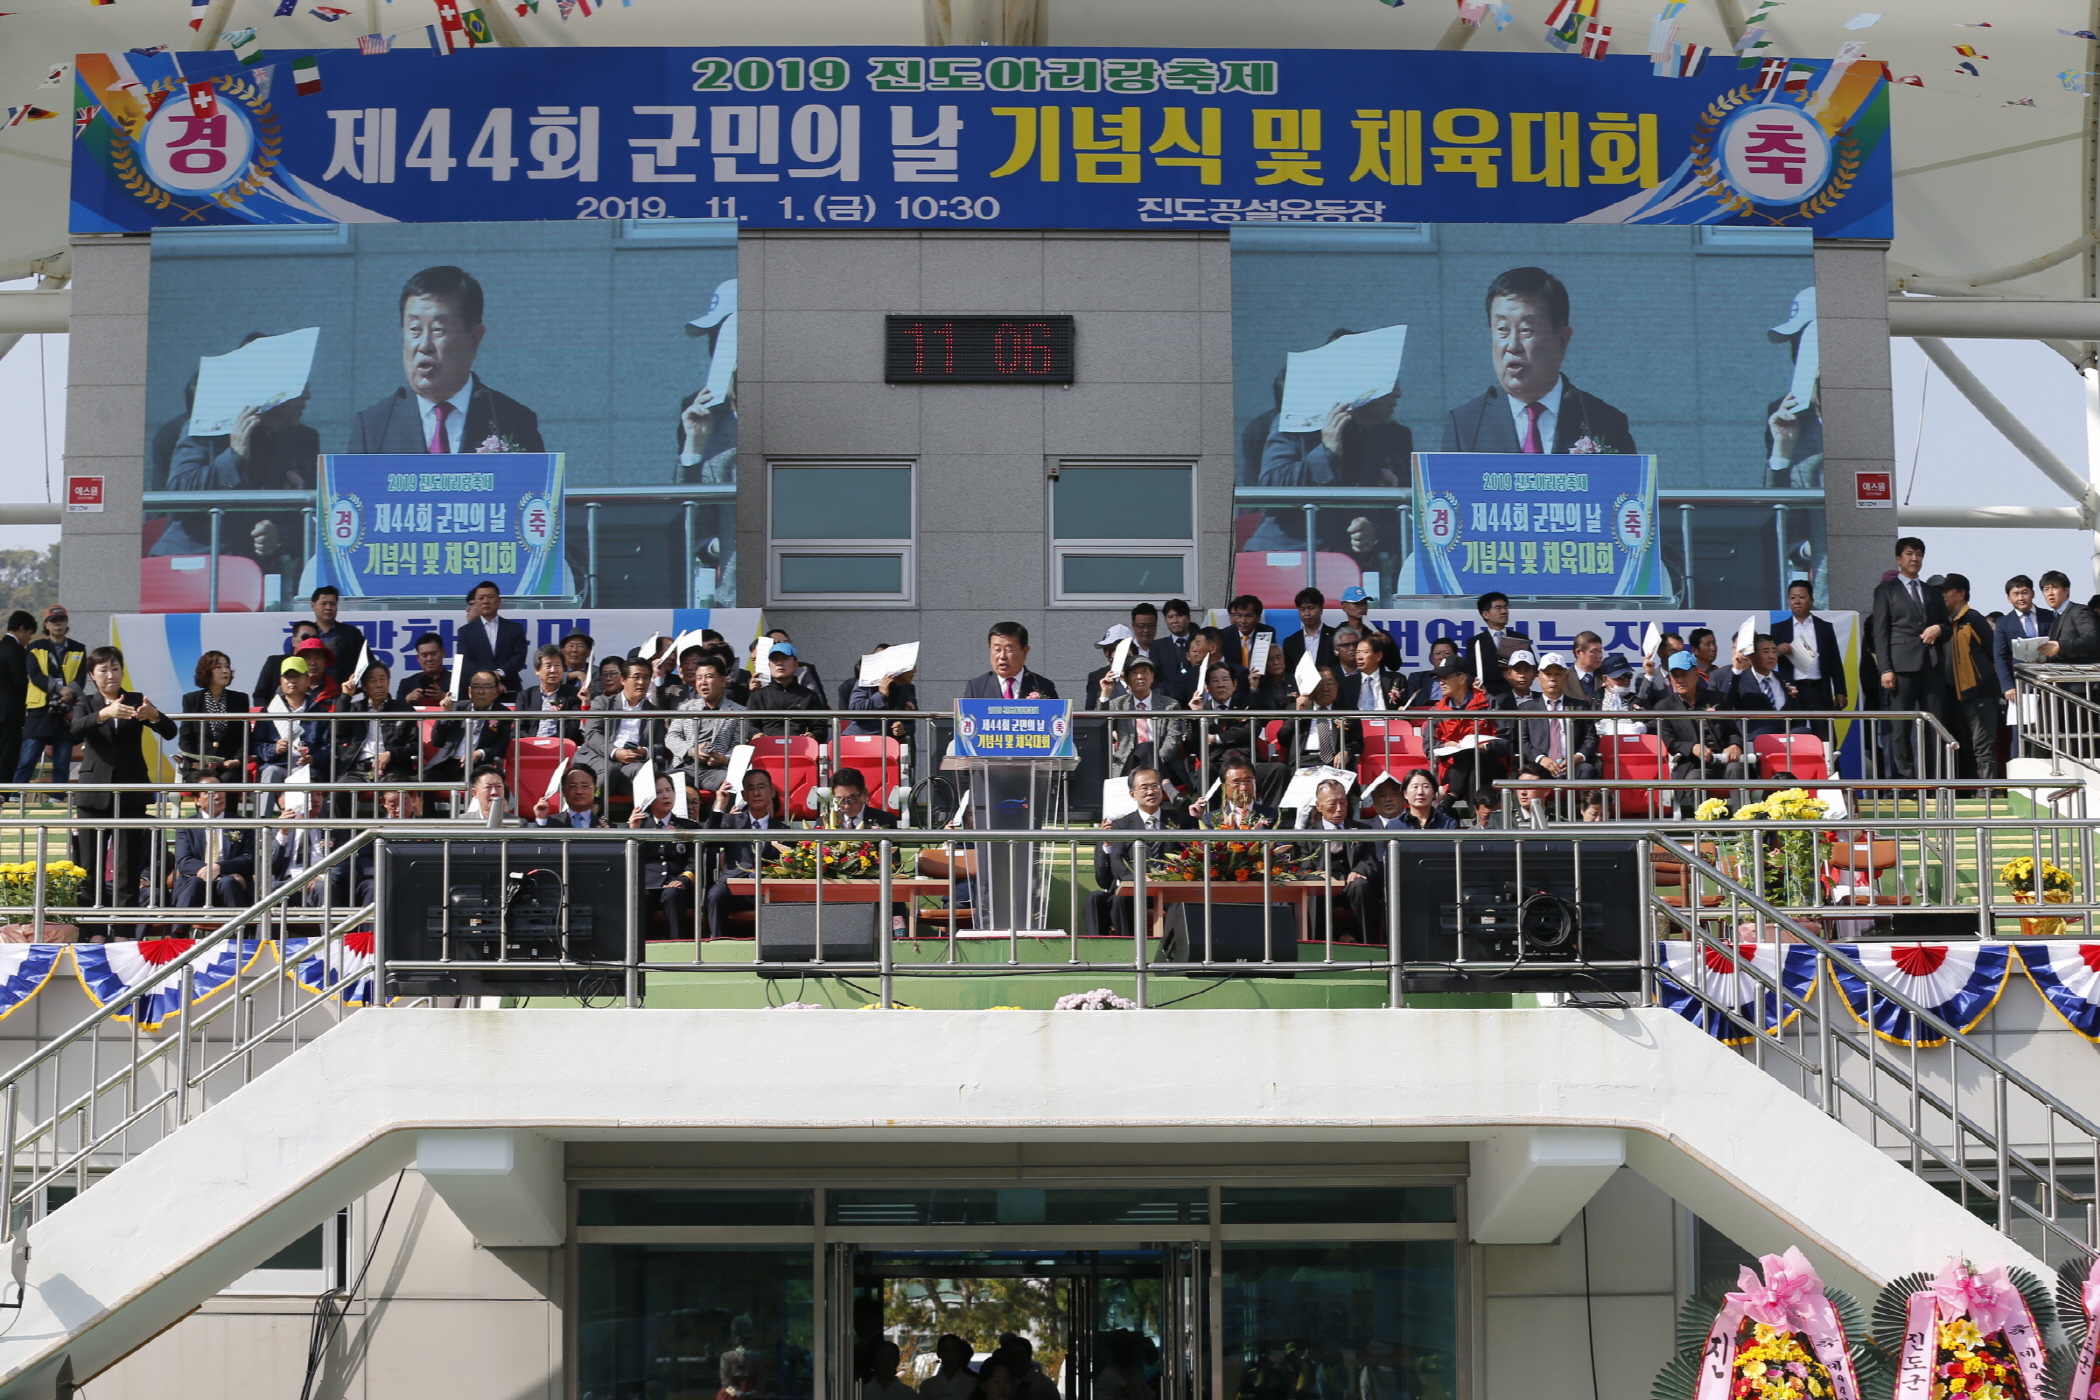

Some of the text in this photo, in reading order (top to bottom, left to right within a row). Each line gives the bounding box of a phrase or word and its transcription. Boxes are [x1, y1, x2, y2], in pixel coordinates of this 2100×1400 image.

[692, 56, 1278, 94] 2019 진도아리랑축제
[166, 112, 227, 174] 경
[322, 104, 1659, 189] 제44회 군민의 날 기념식 및 체육대회
[1744, 124, 1806, 185] 축
[895, 196, 1000, 221] 10:30
[1137, 198, 1386, 223] 진도공설운동장
[75, 486, 98, 496] 에스원
[388, 473, 416, 492] 2019
[1483, 472, 1512, 491] 2019
[1862, 482, 1886, 492] 에스원
[335, 510, 353, 538] 경
[374, 503, 506, 533] 제44회 군민의 날
[529, 509, 545, 538] 축
[1432, 509, 1448, 536] 경
[1471, 502, 1601, 534] 제44회 군민의 날
[1625, 510, 1640, 538] 축
[363, 541, 517, 575] 기념식 및 체육대회
[1462, 541, 1614, 575] 기념식 및 체육대회
[282, 619, 459, 670] 망찬
[981, 719, 1045, 732] 제44회 군민의 날
[977, 734, 1051, 748] 기념식 및 체육대회
[1706, 1332, 1729, 1379] 진
[1902, 1331, 1927, 1391] 진도군
